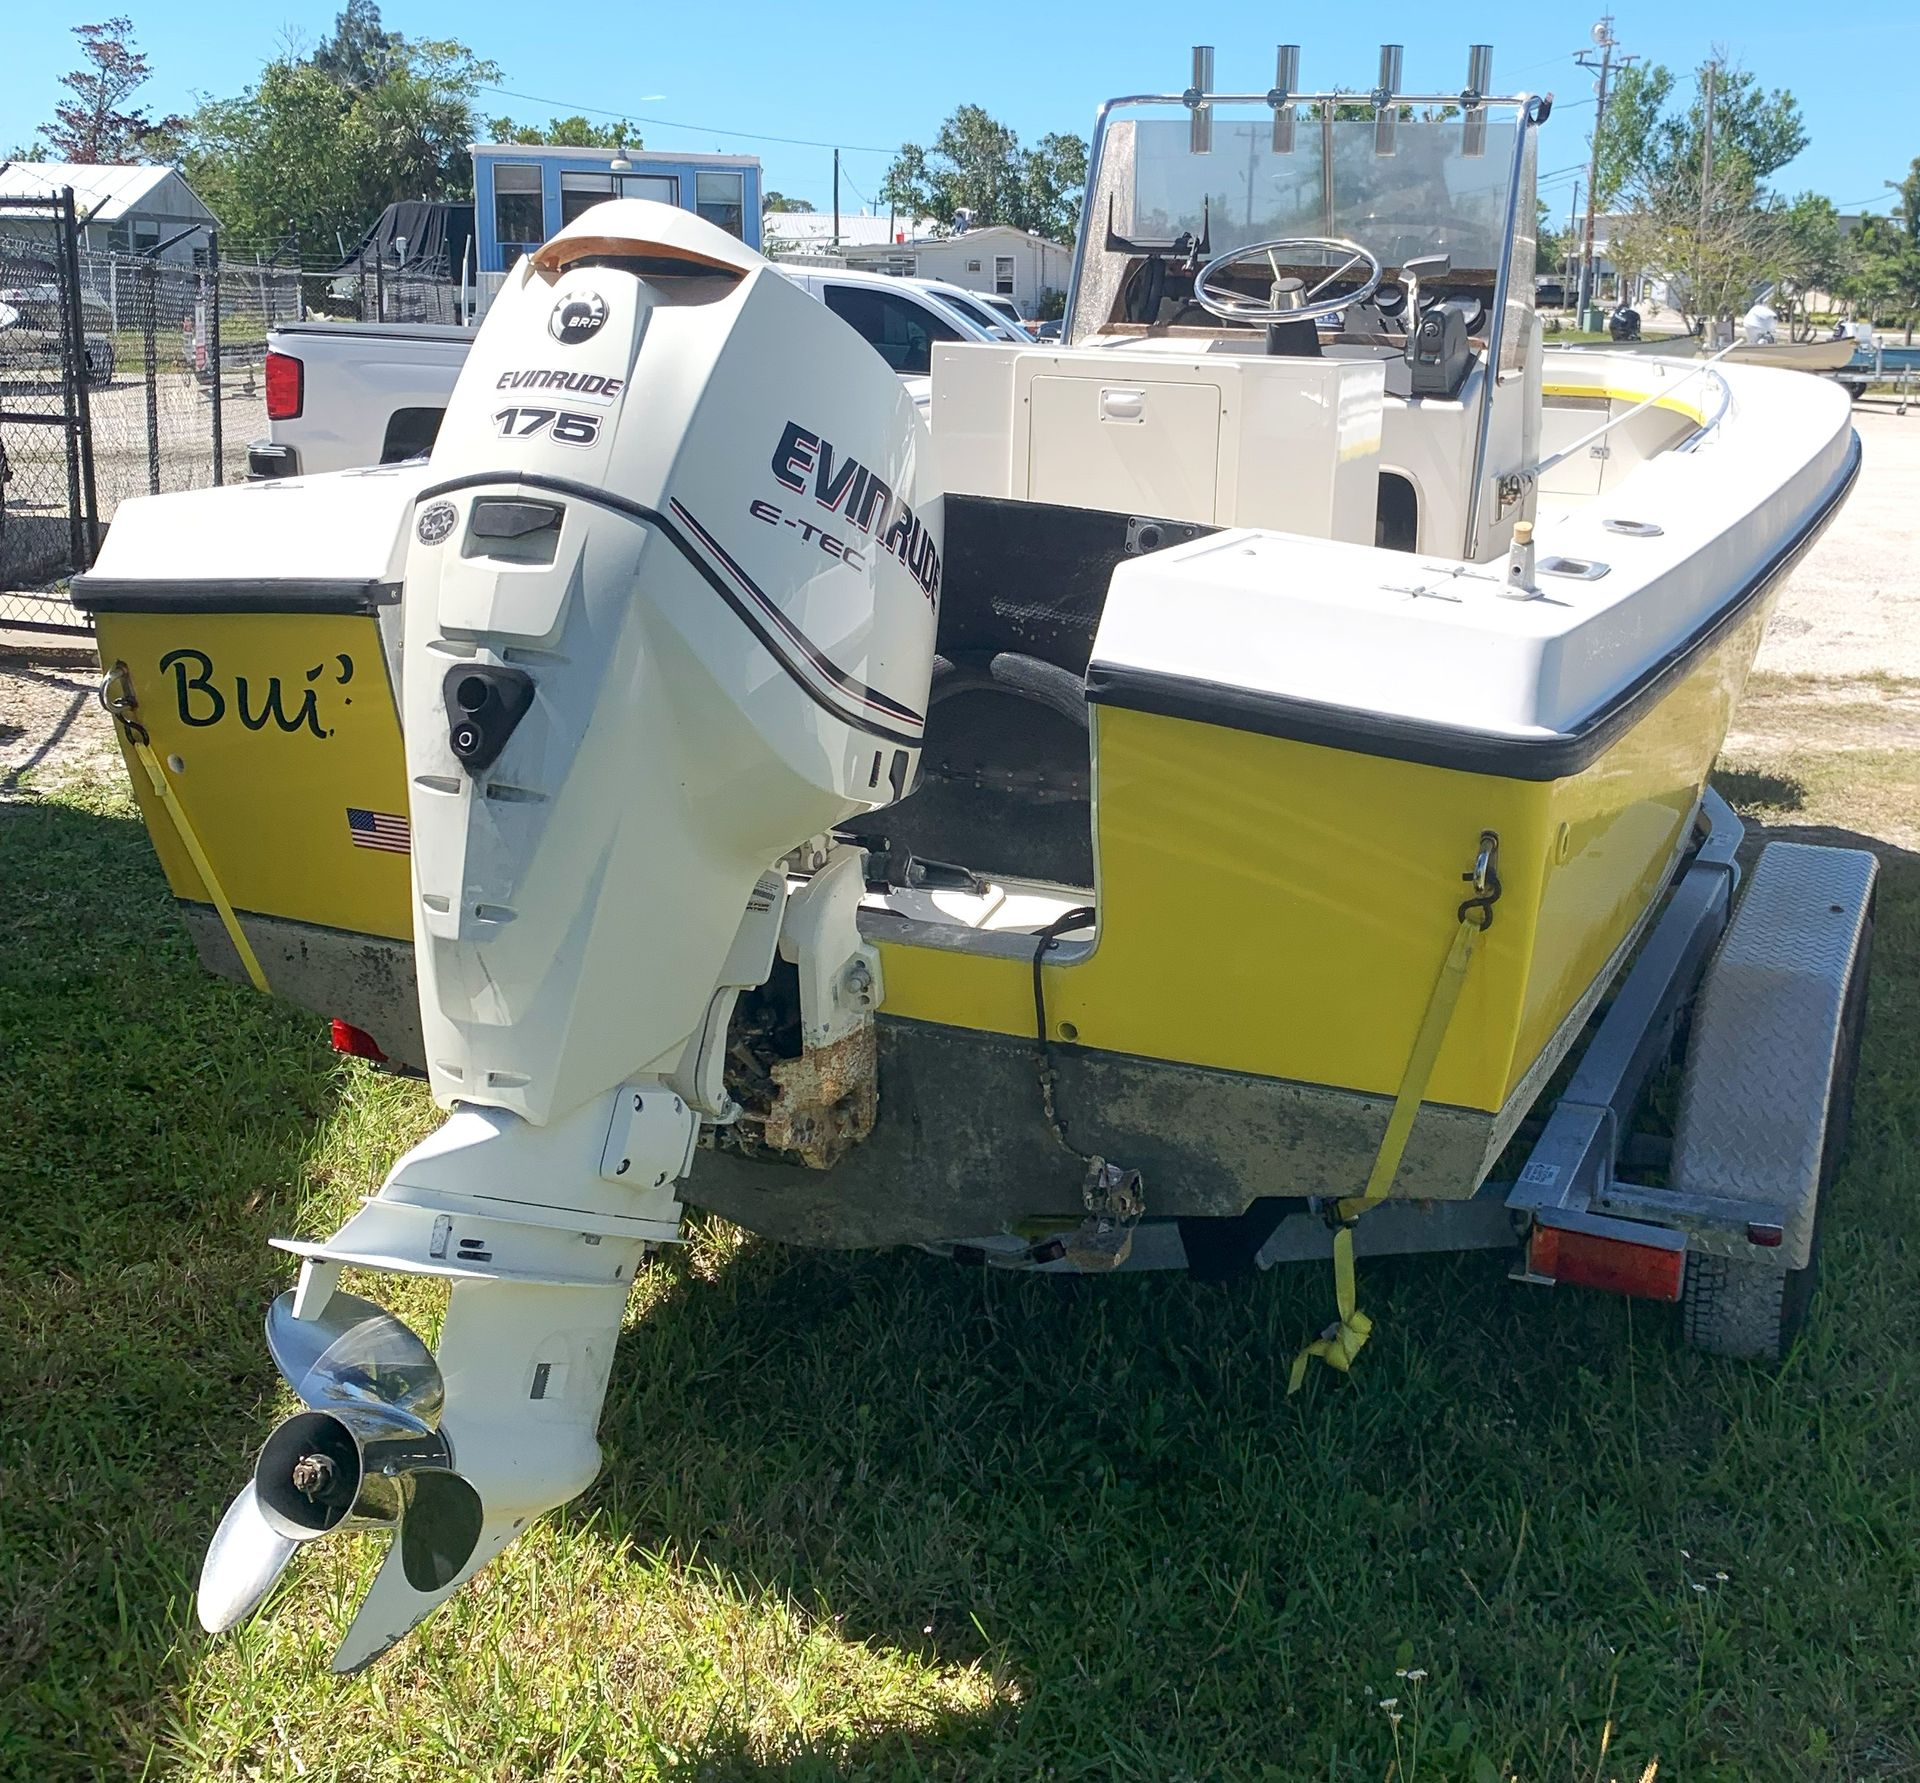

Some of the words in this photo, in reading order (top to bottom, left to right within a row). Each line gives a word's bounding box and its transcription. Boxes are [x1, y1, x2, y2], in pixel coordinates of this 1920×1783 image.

[568, 316, 601, 328] BRP
[495, 369, 624, 396] EVINRUDE
[494, 407, 600, 444] 175
[750, 500, 866, 572] E-TEC
[771, 421, 941, 615] EVINRUDE
